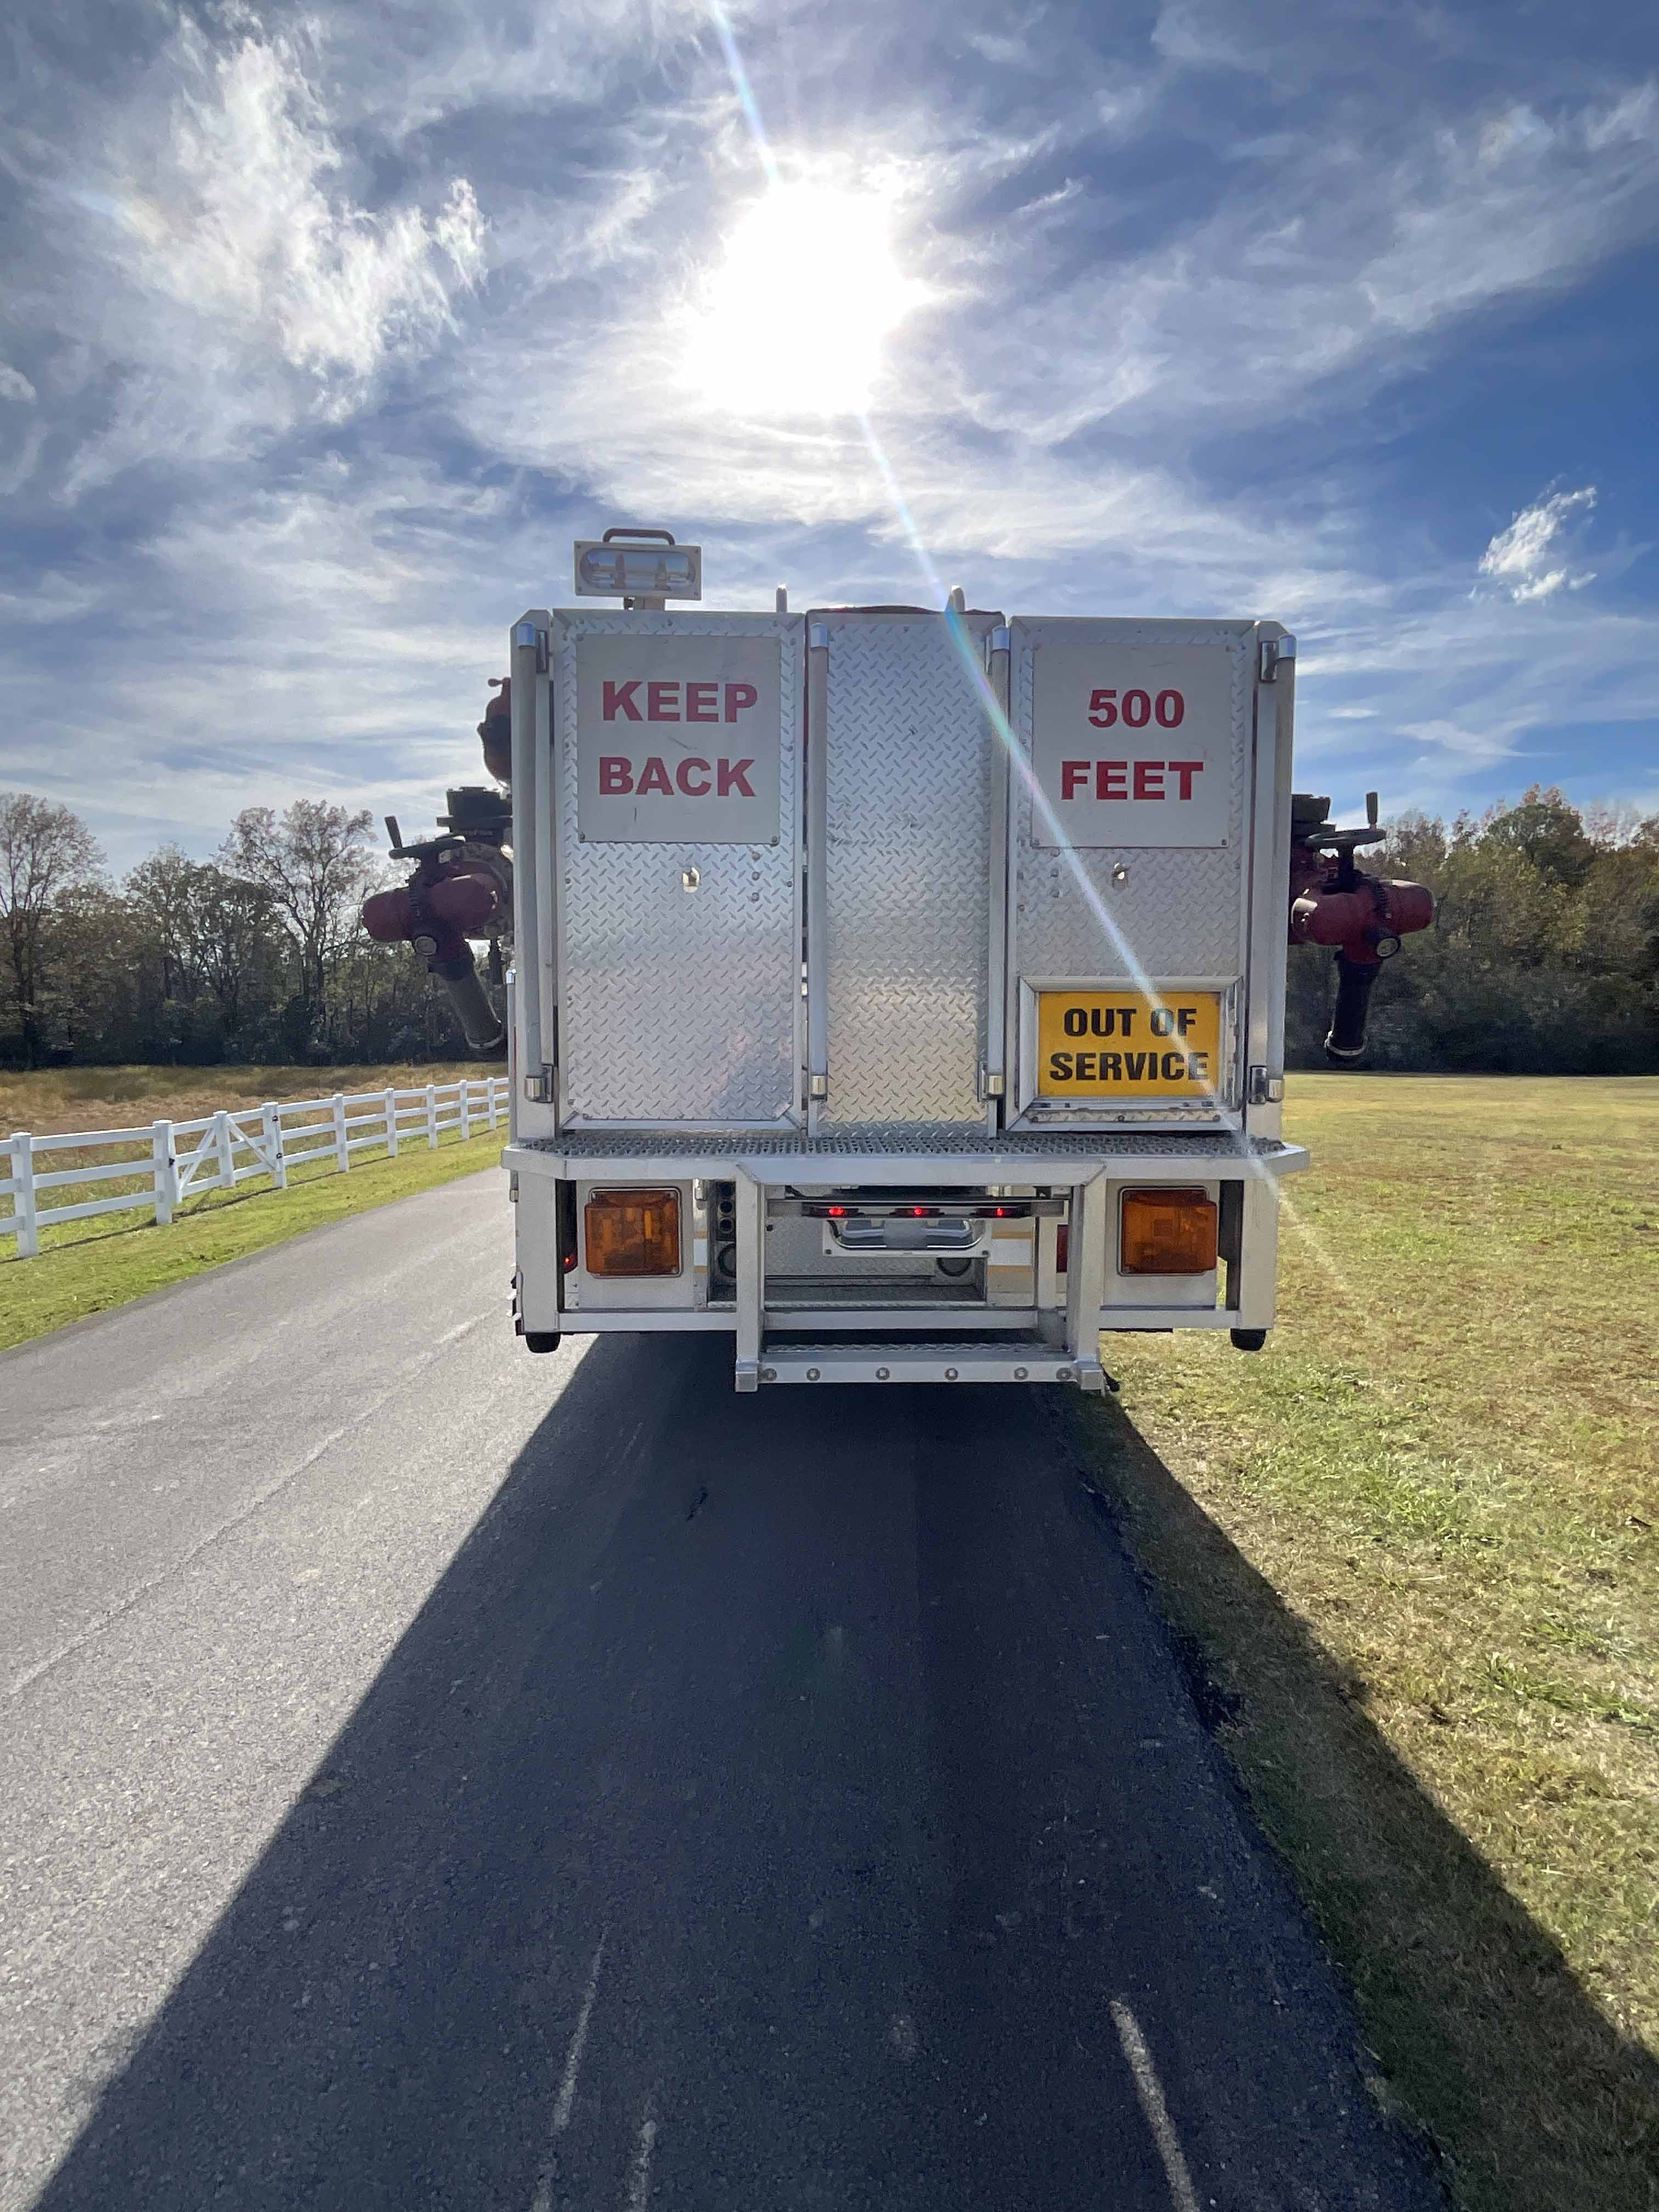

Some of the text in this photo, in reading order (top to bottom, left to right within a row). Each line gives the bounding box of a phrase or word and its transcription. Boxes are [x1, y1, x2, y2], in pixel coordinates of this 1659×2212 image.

[602, 681, 758, 723] KEEP
[1088, 689, 1185, 728] 500
[599, 757, 756, 797] BACK
[1061, 761, 1204, 800] FEET
[1064, 1008, 1197, 1037] OUT OF
[1049, 1052, 1209, 1080] SERVICE
